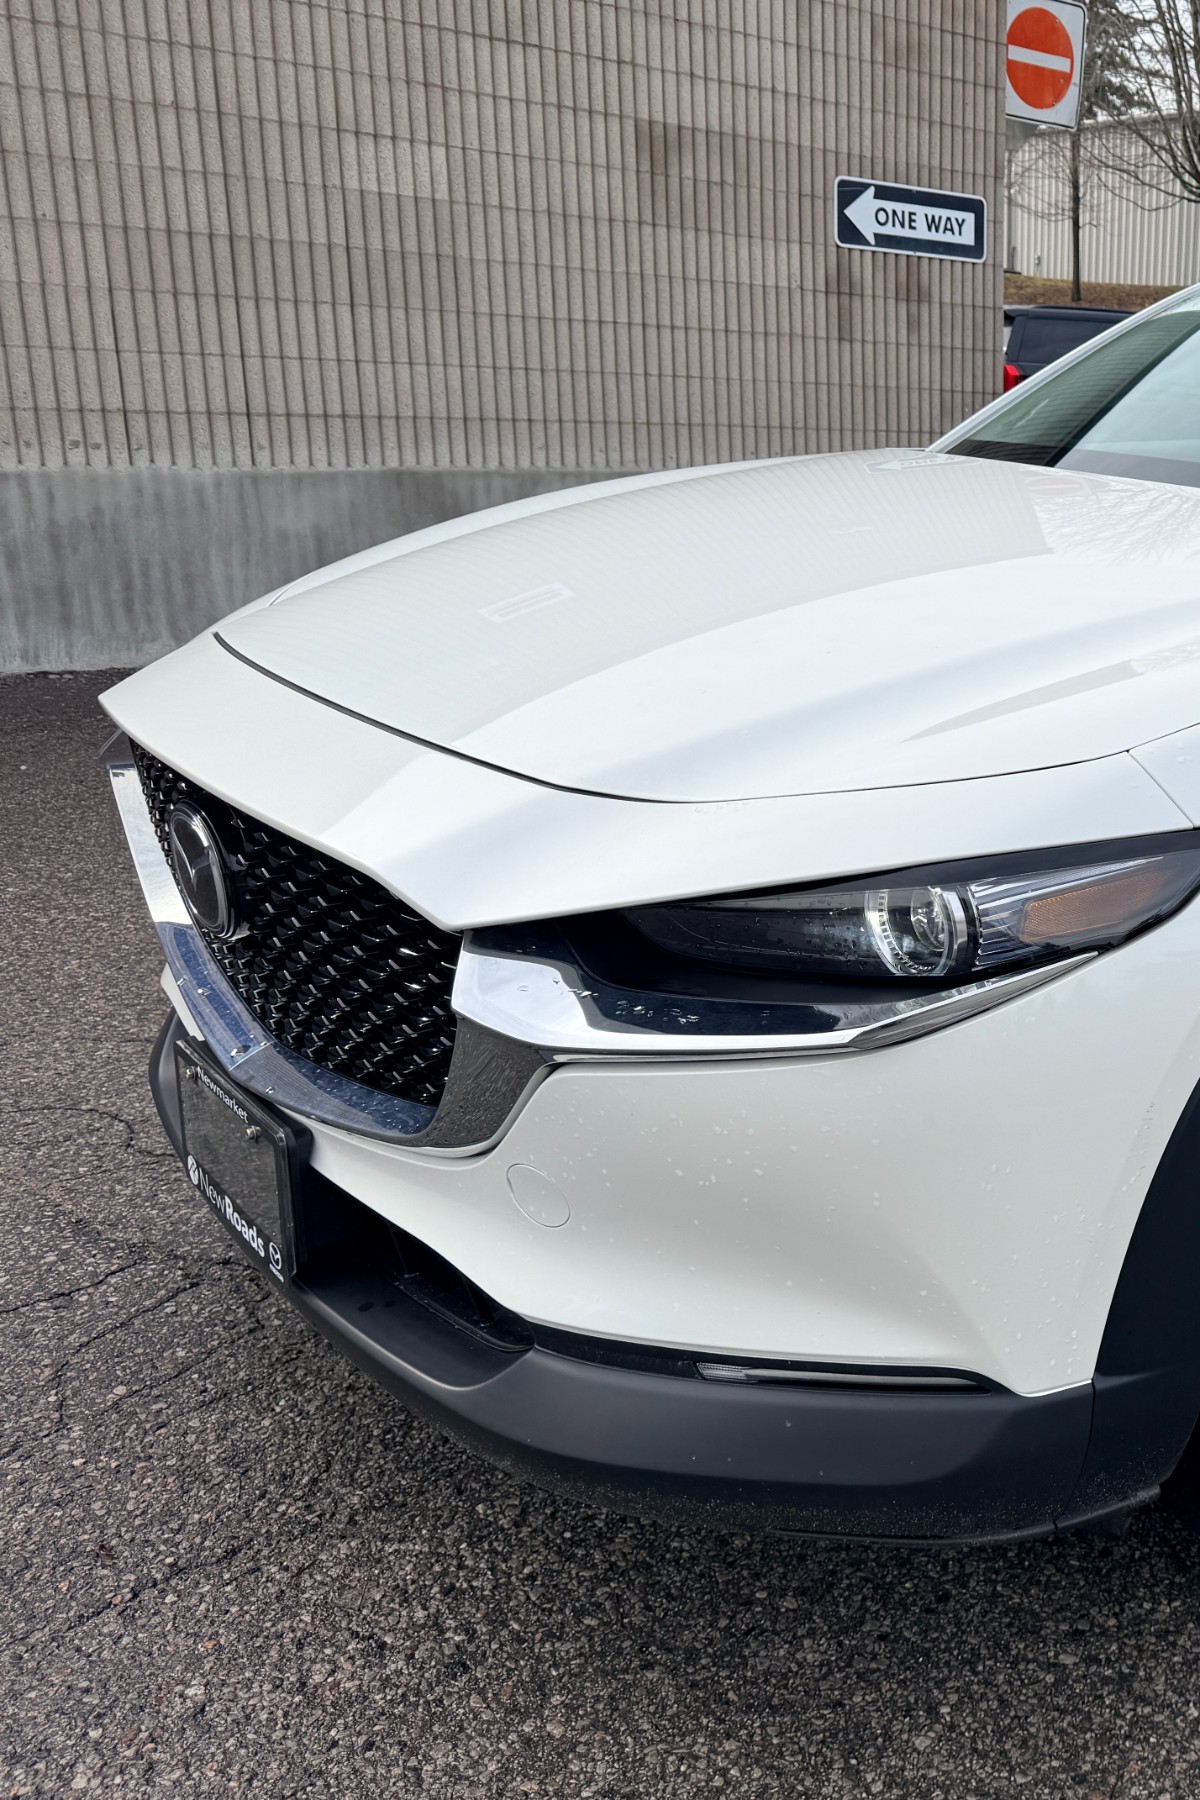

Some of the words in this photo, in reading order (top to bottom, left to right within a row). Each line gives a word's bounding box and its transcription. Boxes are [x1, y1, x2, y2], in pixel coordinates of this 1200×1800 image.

[875, 207, 917, 230] ONE
[924, 213, 965, 236] WAY
[197, 1066, 249, 1123] Newmarket
